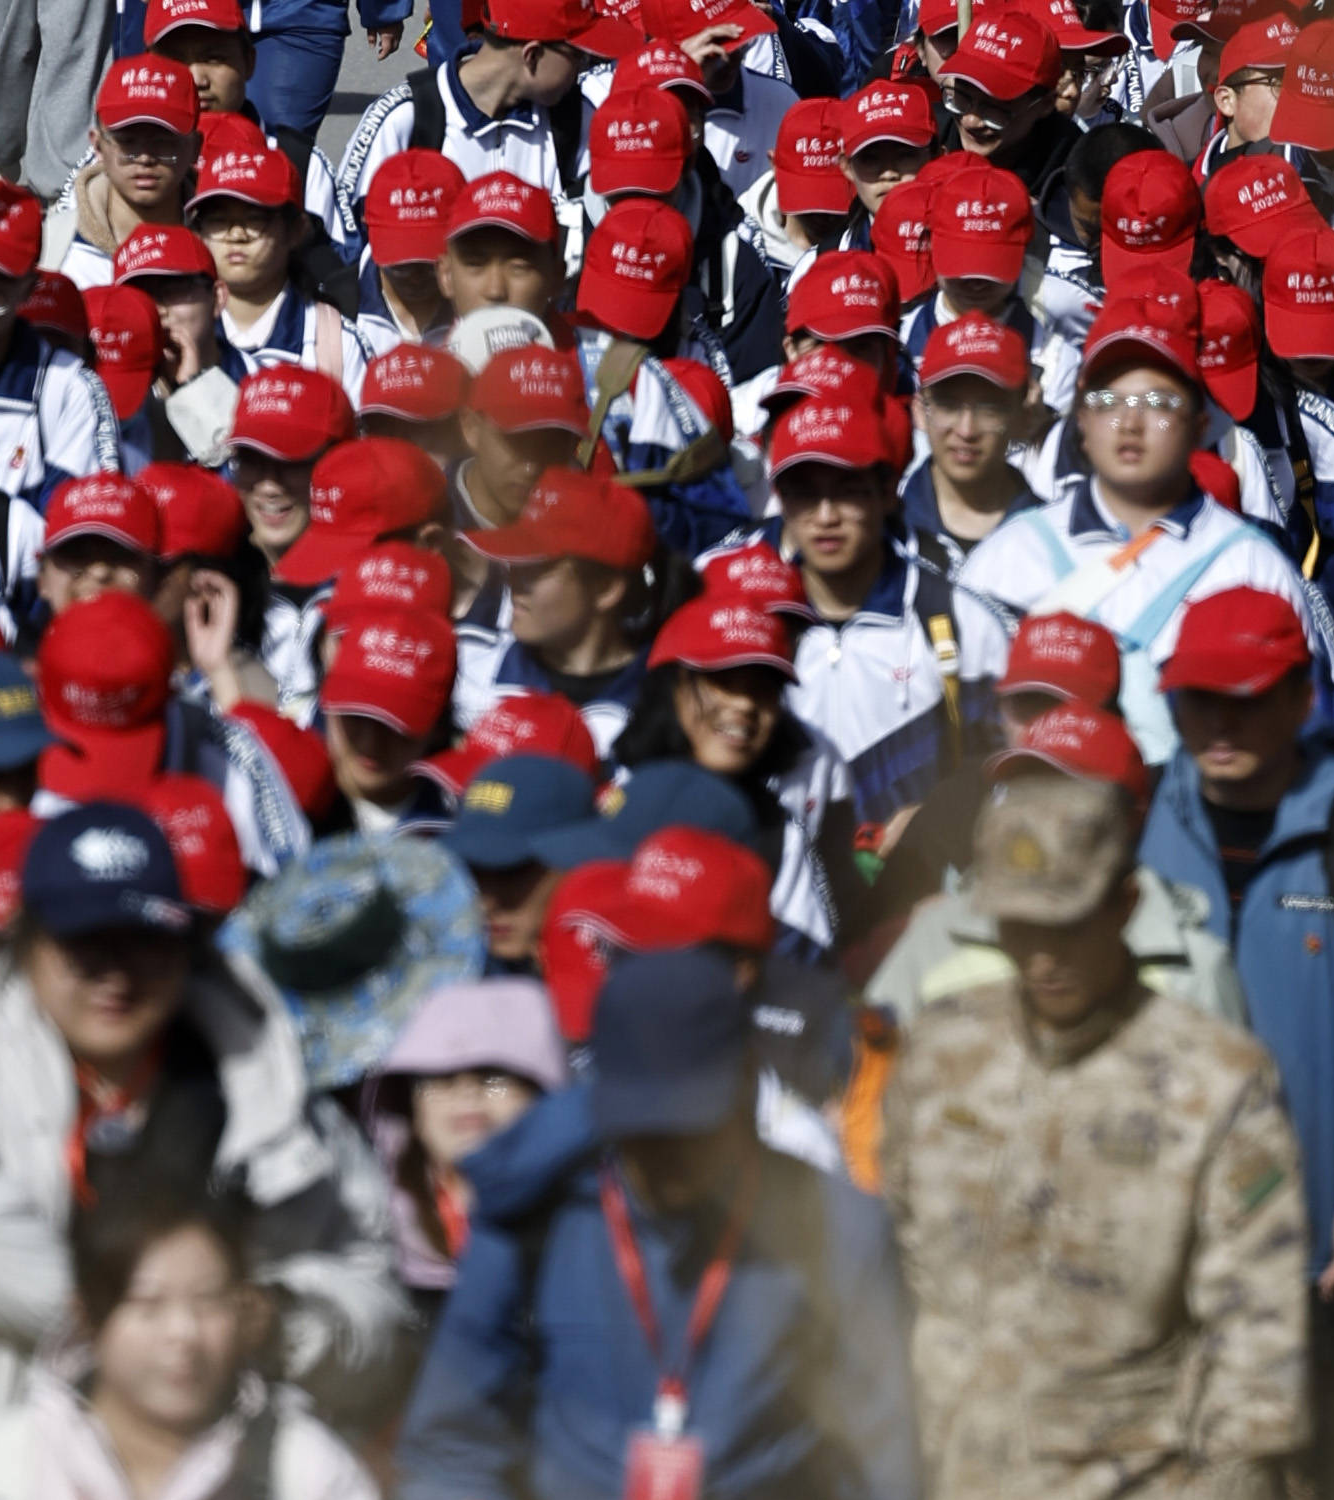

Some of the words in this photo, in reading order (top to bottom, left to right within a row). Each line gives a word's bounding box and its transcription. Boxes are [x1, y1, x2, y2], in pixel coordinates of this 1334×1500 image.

[976, 24, 1021, 49] 固原二中
[858, 91, 908, 112] 固原二中
[608, 119, 659, 138] 固原二中
[390, 187, 443, 205] 固原二中
[1238, 173, 1284, 204] 固原二中
[957, 202, 1007, 218] 固原二中
[612, 242, 666, 266] 固原二中
[1295, 290, 1334, 304] 2025级
